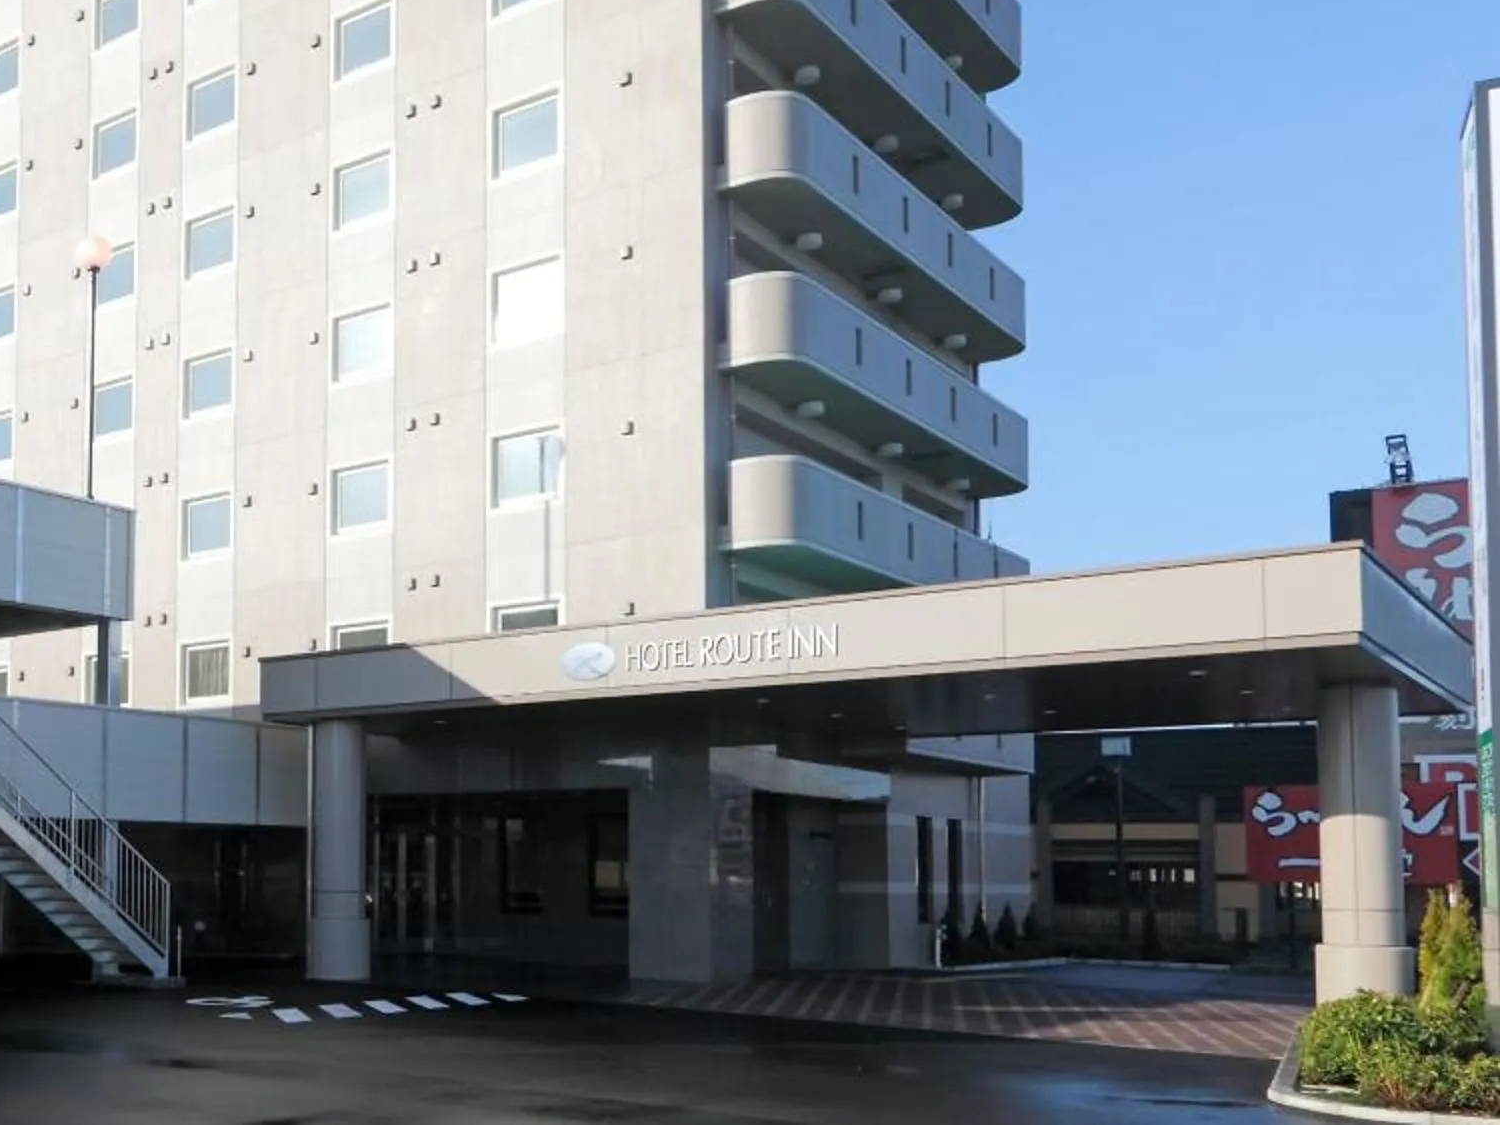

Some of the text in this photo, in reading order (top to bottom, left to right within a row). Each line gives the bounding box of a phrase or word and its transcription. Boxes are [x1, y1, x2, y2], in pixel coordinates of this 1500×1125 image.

[625, 623, 840, 672] HOTEL ROUTE INN
